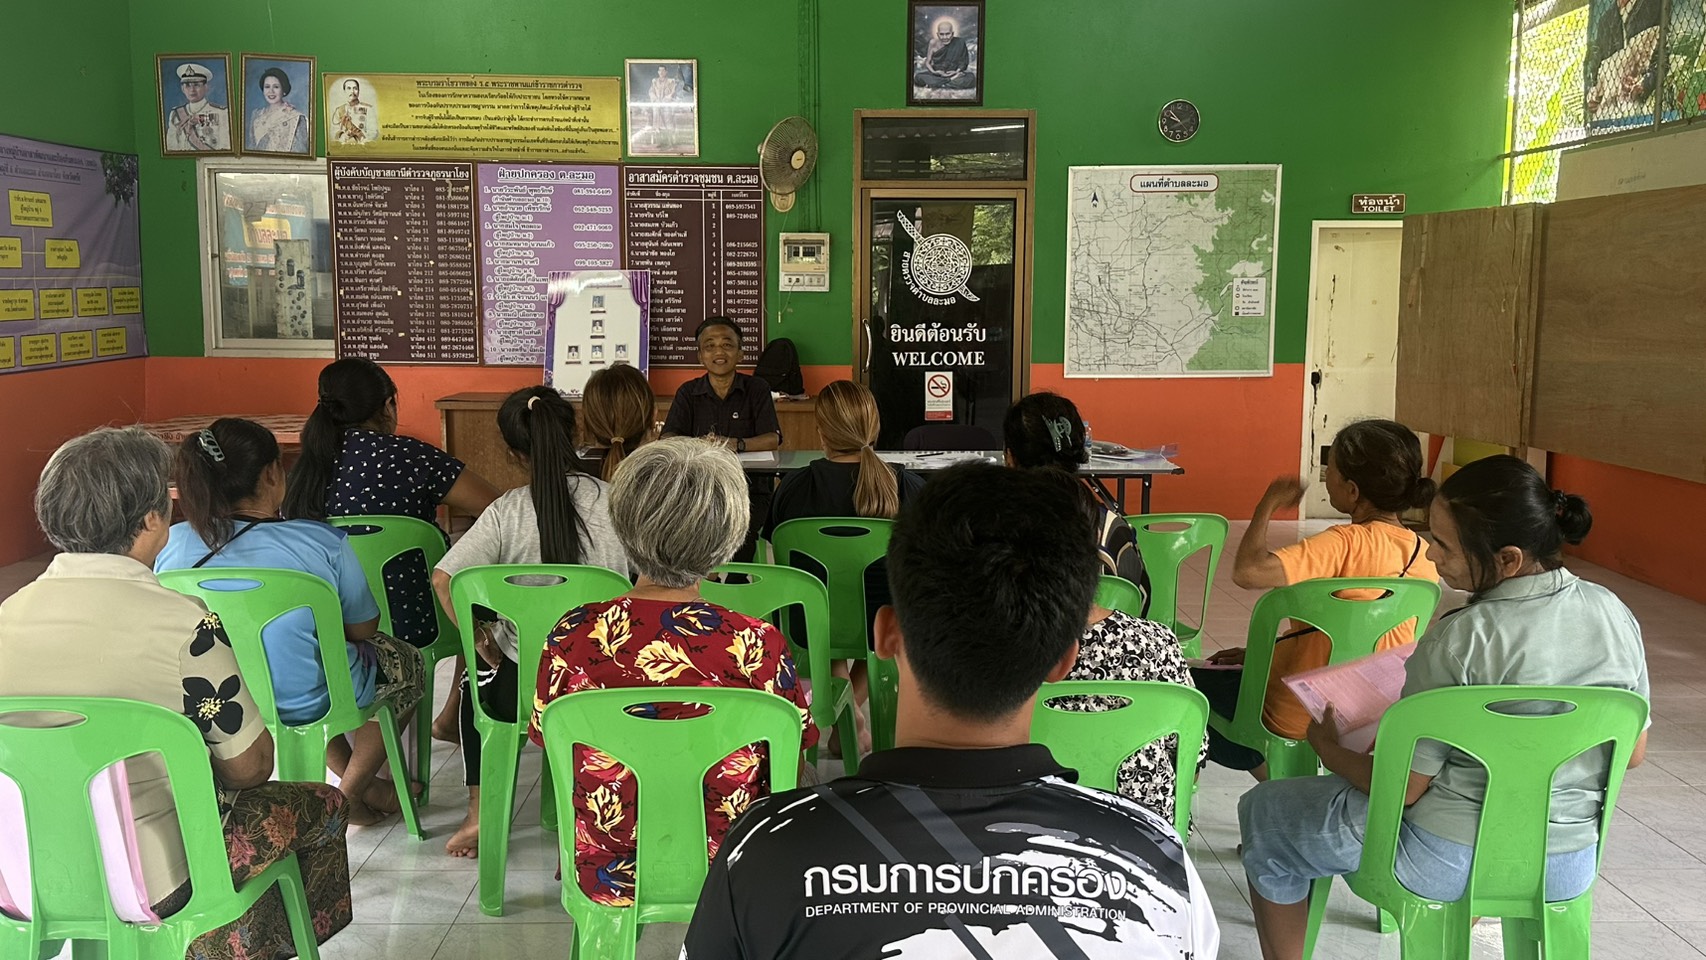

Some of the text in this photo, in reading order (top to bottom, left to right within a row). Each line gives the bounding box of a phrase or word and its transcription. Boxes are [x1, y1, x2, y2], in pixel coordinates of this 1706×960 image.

[334, 165, 469, 181] ผู้บังคับบัญชาสถานีตำรวจภูธรนาโยง
[498, 168, 595, 180] ฝ่ายปกครอง ต.ละมอ
[628, 170, 758, 188] อาสาสมัครตำรวจชุมชน ต.ละมอ
[1140, 176, 1209, 189] แผนที่ตำบลละมอ
[1358, 194, 1400, 206] ห้องน้ำ
[890, 323, 987, 343] ยินดีต้อนรับ
[892, 351, 986, 366] WELCOME
[804, 857, 1127, 900] กรมการปกครอง
[805, 902, 1127, 922] DEPARTMENT OF PROVINCIAL ADMINISTRATION
